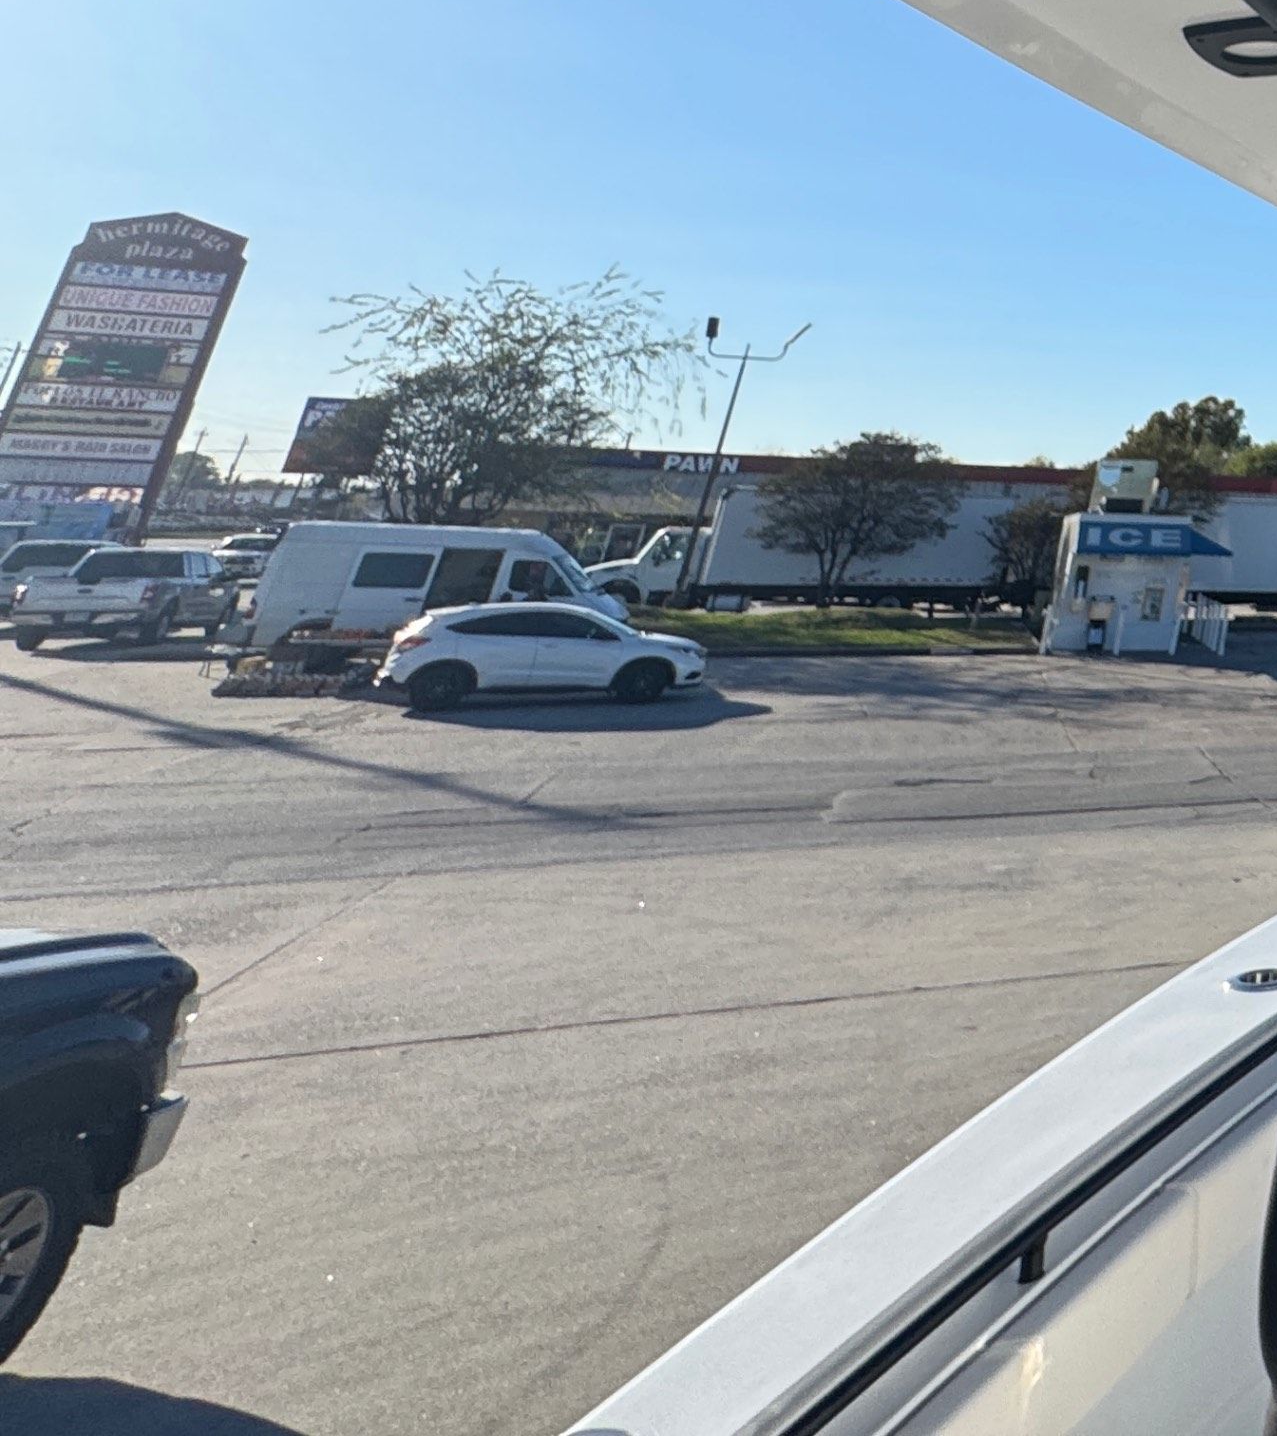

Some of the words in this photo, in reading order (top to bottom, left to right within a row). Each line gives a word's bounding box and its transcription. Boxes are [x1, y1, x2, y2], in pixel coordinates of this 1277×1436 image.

[124, 241, 194, 261] plaza
[138, 293, 214, 315] FASHION
[65, 313, 193, 336] WASHATERIA
[663, 453, 740, 474] PAWN
[1086, 526, 1182, 549] ICE
